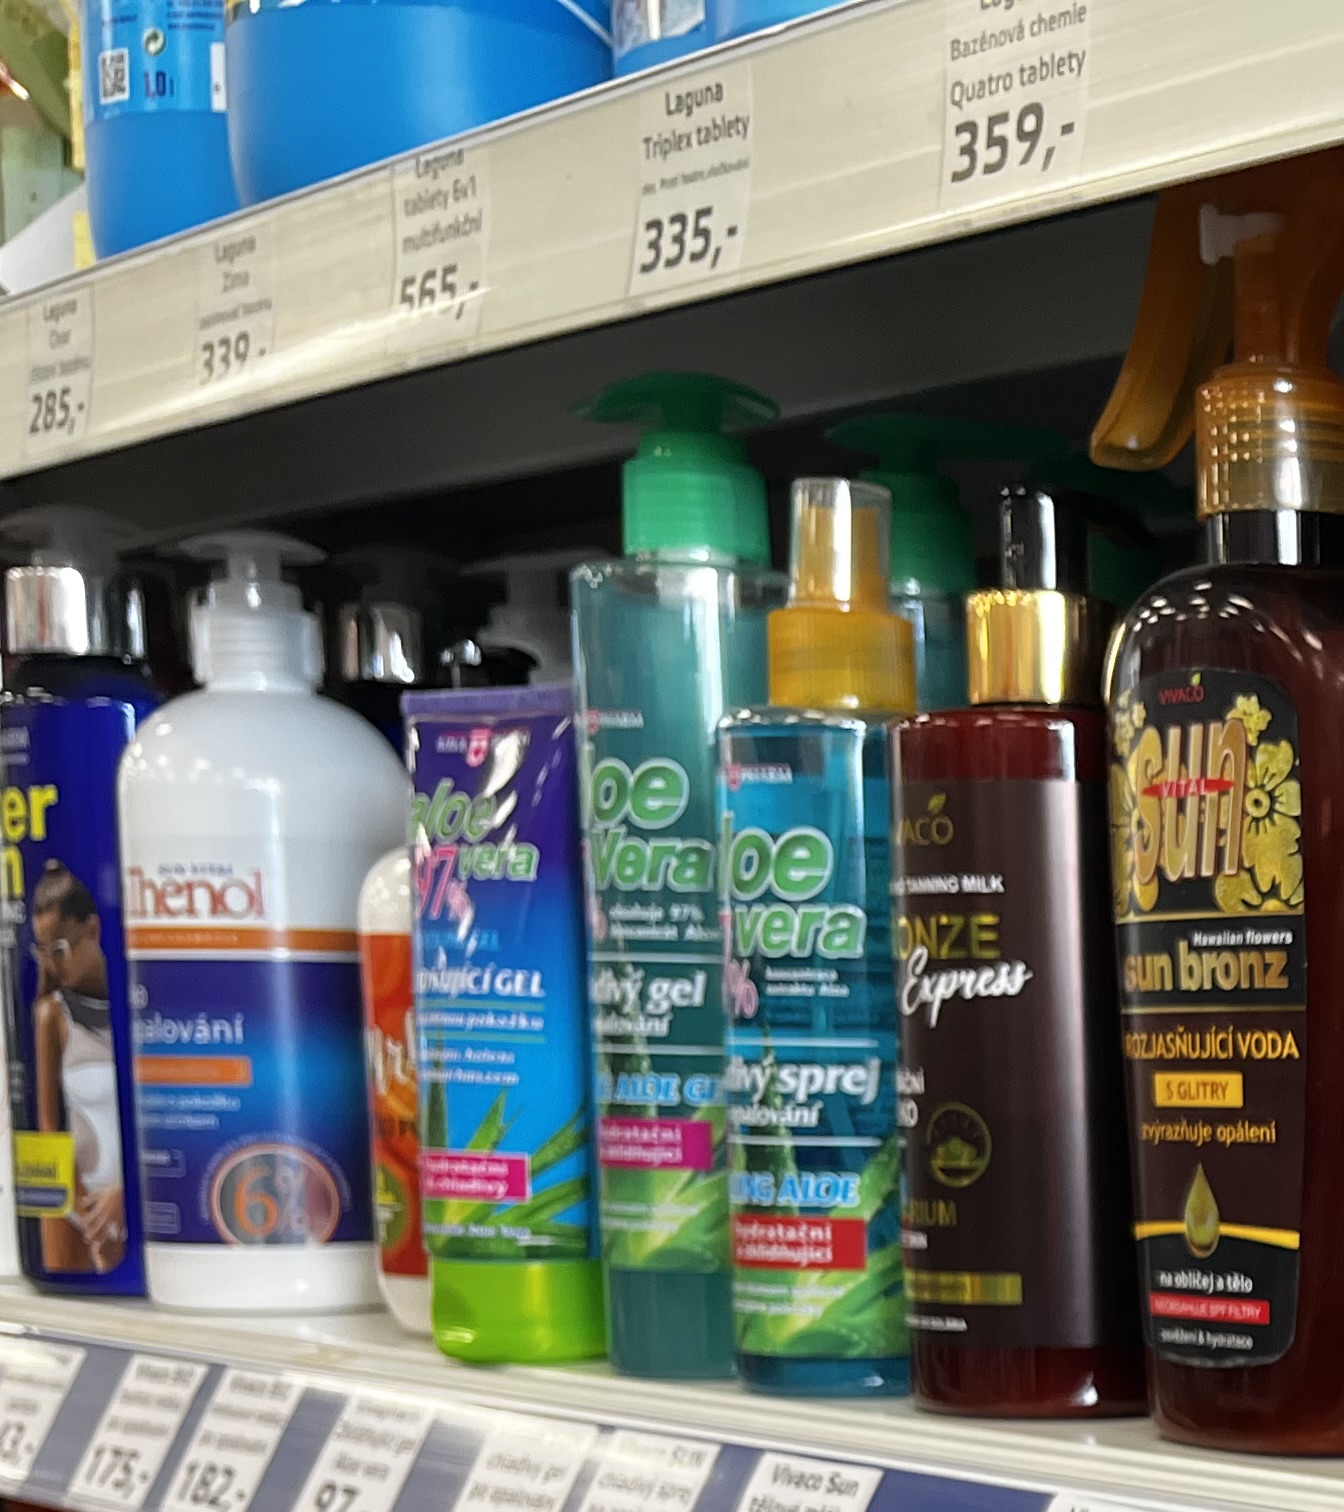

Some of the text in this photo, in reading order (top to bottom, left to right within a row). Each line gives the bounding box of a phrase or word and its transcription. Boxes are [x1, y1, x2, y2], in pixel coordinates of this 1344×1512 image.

[948, 2, 1089, 62] Bazénová chemie
[664, 79, 725, 118] Laguna
[948, 45, 1088, 110] Quatro tablety
[643, 111, 751, 161] Triplex tablety
[950, 102, 1076, 184] 359,-
[638, 206, 740, 276] 335,-
[902, 945, 1033, 1029] Express
[1180, 942, 1290, 991] bronz
[647, 969, 707, 1015] gel
[1238, 1030, 1300, 1060] VODA
[778, 1056, 880, 1105] sprej
[1179, 1080, 1230, 1102] GLITRY
